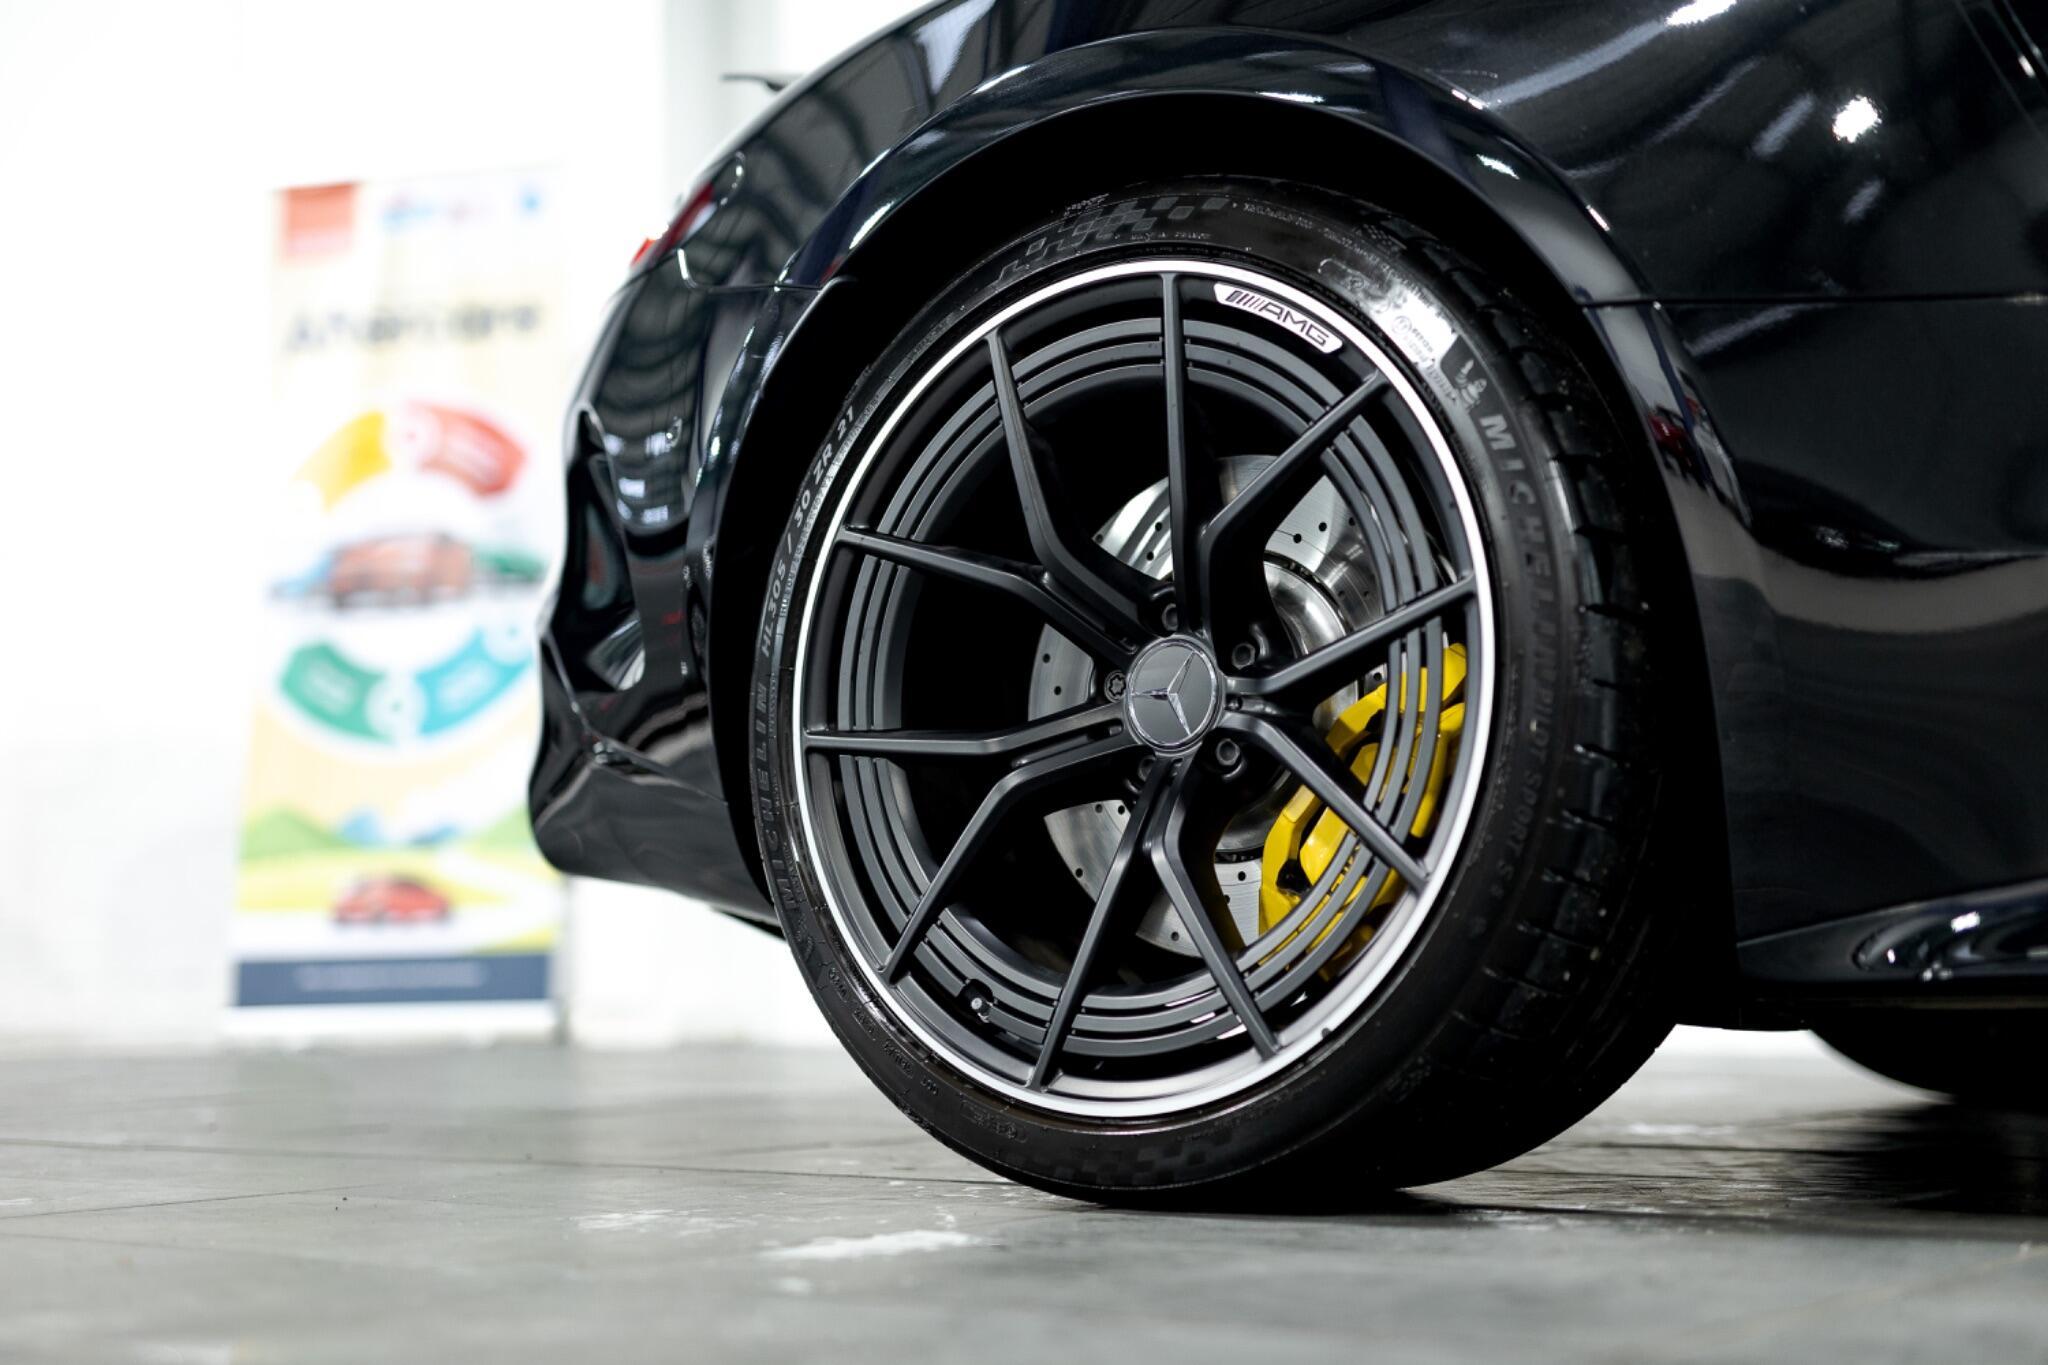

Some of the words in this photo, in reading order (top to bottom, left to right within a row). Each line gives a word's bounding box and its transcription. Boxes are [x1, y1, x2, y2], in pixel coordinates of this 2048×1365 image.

[1258, 300, 1330, 347] AMG
[794, 489, 811, 528] 30
[813, 442, 832, 486] ZR
[837, 404, 854, 442] 21
[1478, 412, 1558, 684] MICHELIN
[755, 681, 799, 911] MICHELIN
[1504, 768, 1543, 858] SPORT
